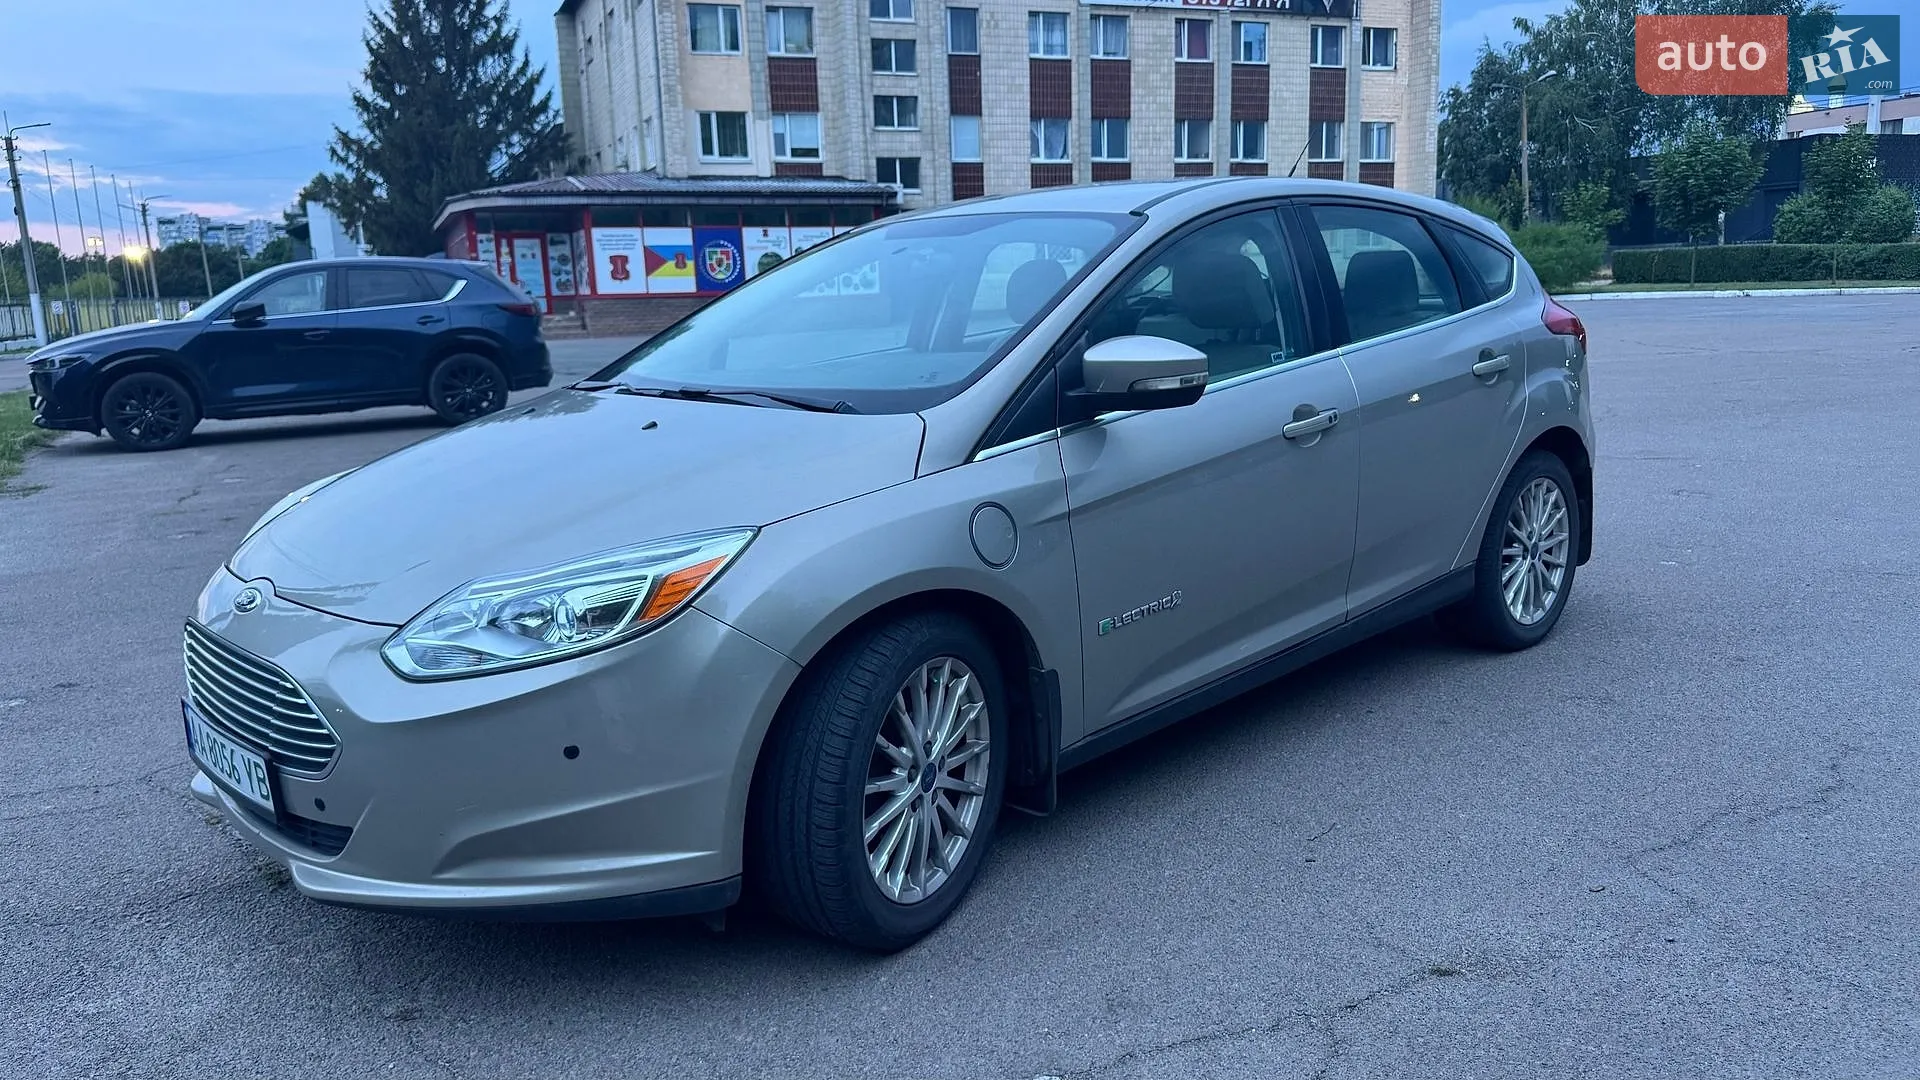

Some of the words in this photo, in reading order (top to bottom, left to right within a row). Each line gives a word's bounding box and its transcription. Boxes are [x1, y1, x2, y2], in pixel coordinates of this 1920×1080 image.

[1098, 595, 1172, 635] ELECTRIC
[206, 731, 241, 785] 8056
[240, 753, 270, 801] YB
